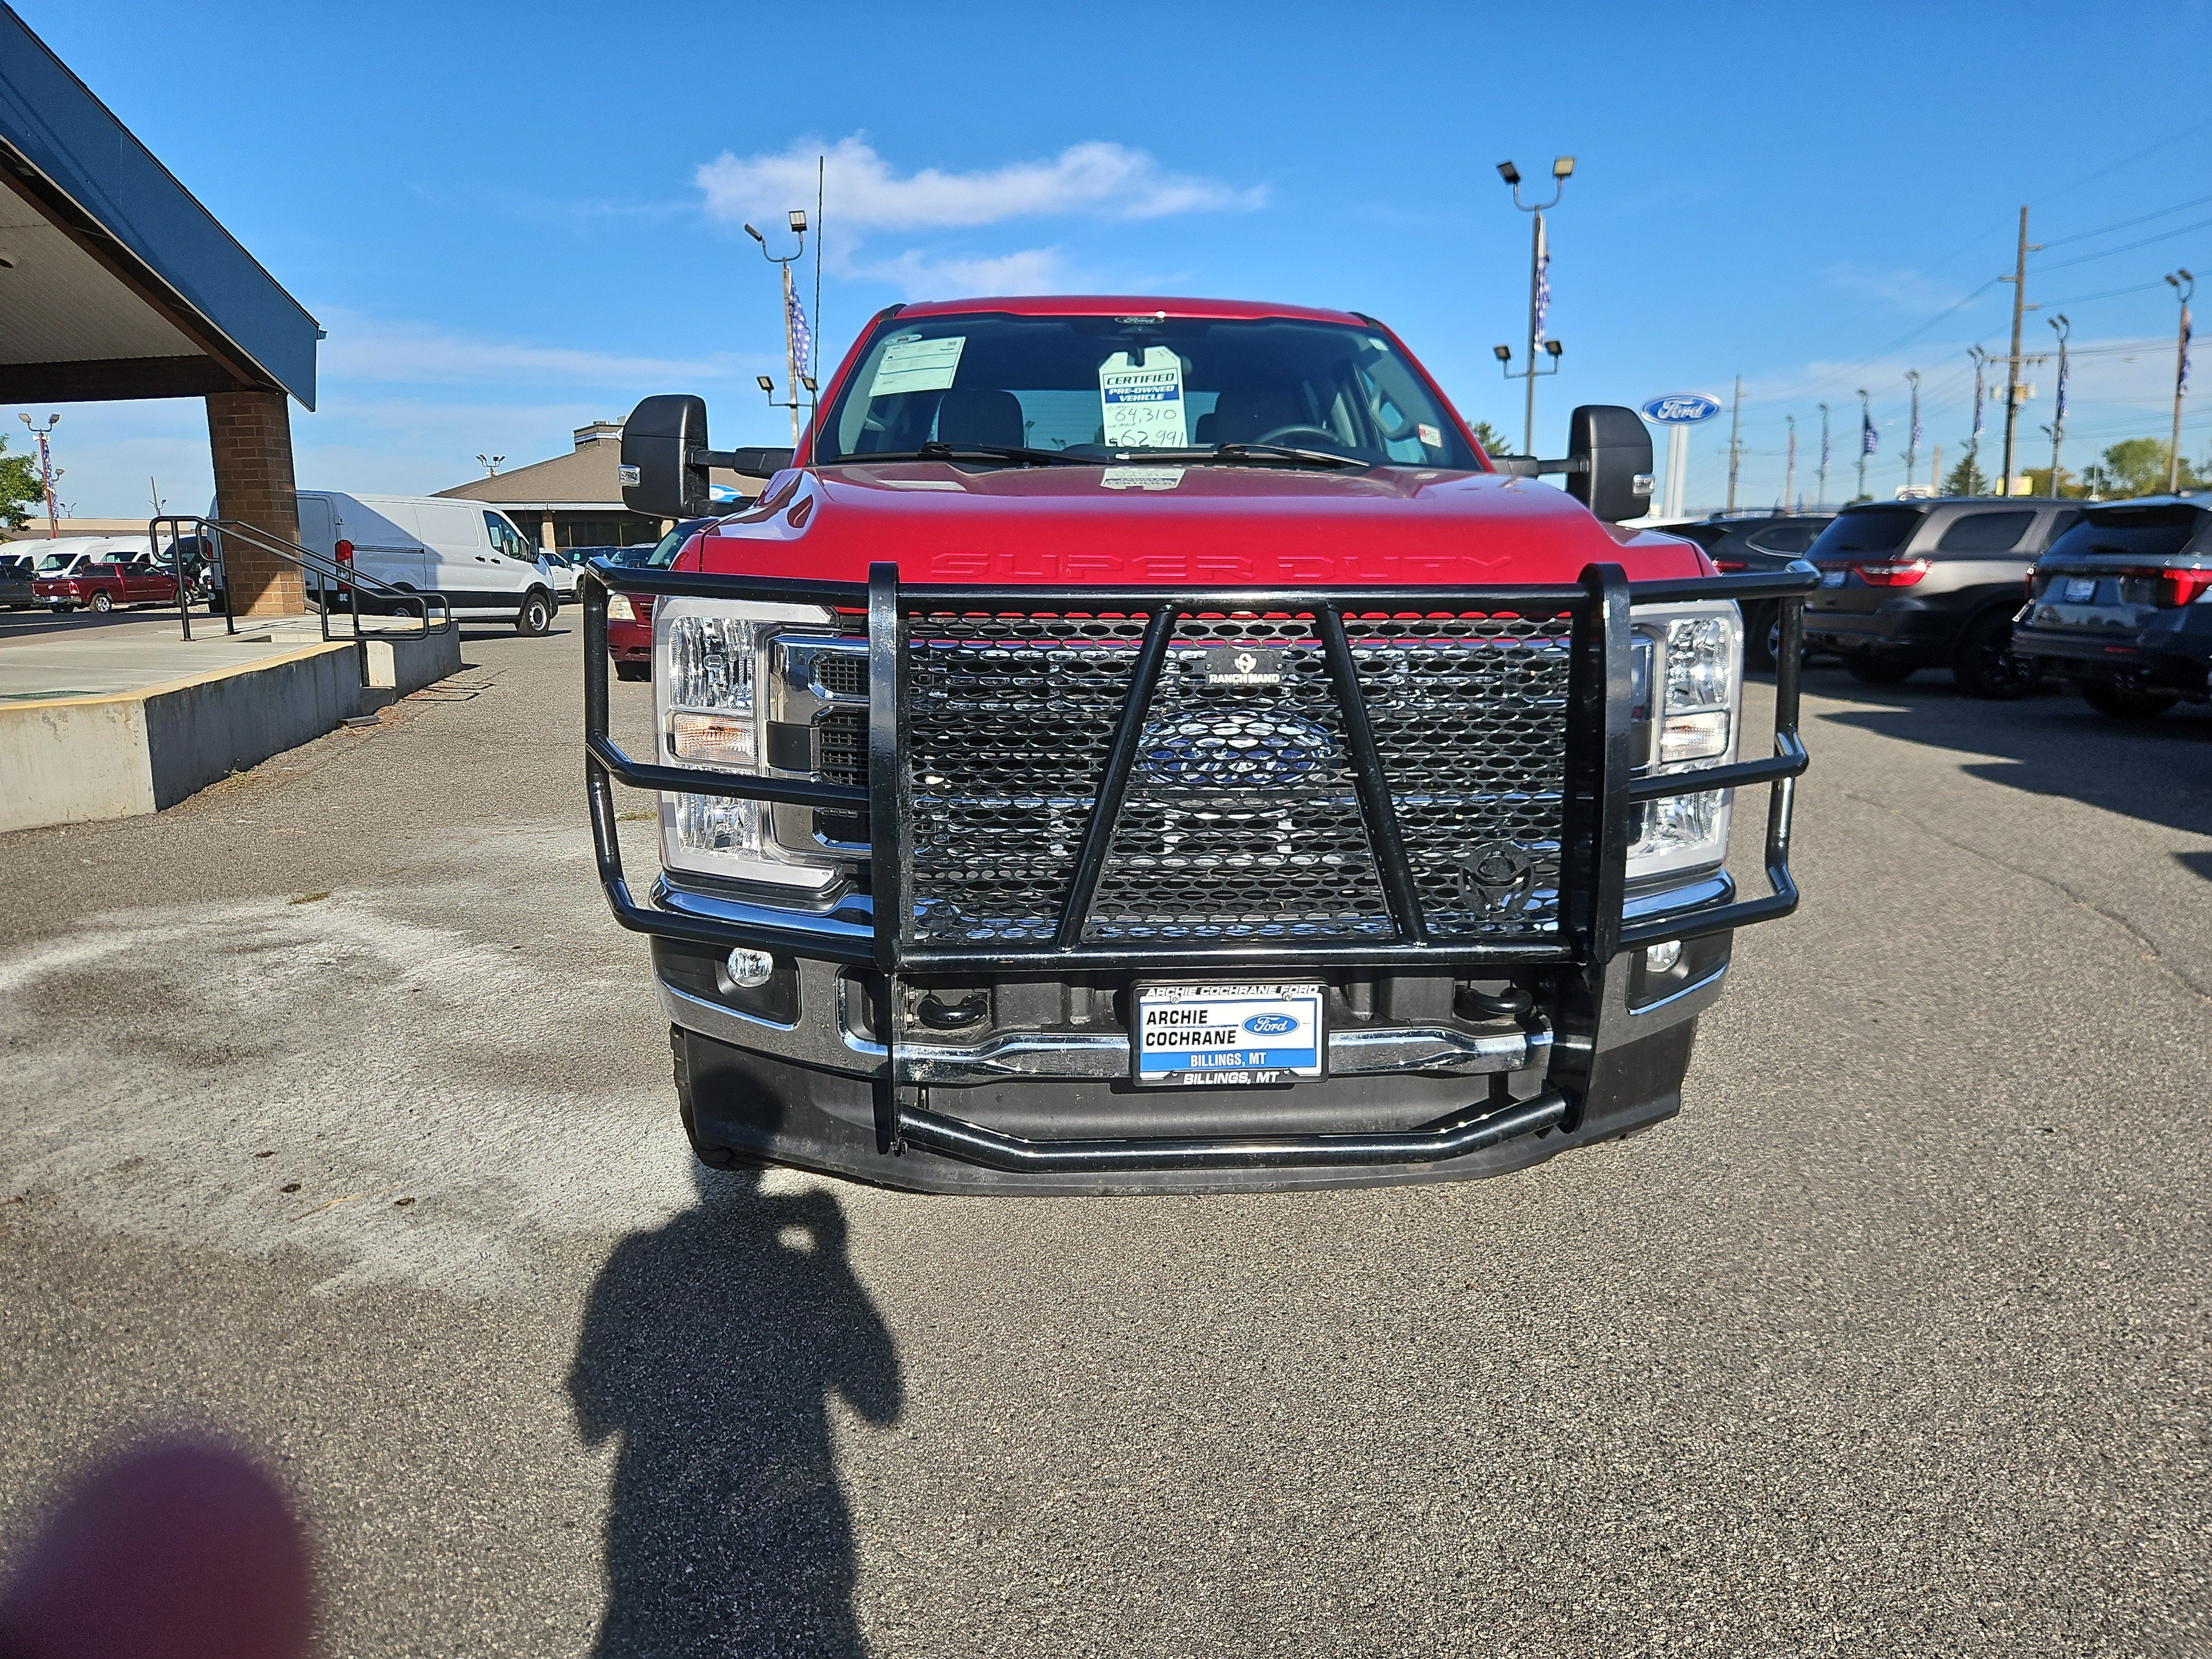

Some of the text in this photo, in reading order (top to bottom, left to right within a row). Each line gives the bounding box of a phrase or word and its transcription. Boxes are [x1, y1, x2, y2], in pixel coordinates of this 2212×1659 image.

[1107, 373, 1174, 385] CERTIFIED
[1109, 385, 1174, 395] PRE-OWNED
[1119, 394, 1165, 402] VEHICLE
[1115, 408, 1176, 423] 64,310
[1658, 398, 1706, 419] Ford
[931, 553, 1511, 580] SUPER DUTY
[1209, 674, 1246, 684] RANCH
[1146, 985, 1319, 997] ARCHIE COCHRANE FORD
[1146, 1009, 1208, 1025] ARCHIE
[1254, 1017, 1287, 1032] Ford
[1146, 1030, 1236, 1046] COCHRANE
[1191, 1052, 1267, 1067] BILLINGS, MT
[1183, 1071, 1280, 1085] BILLINGS, MT
